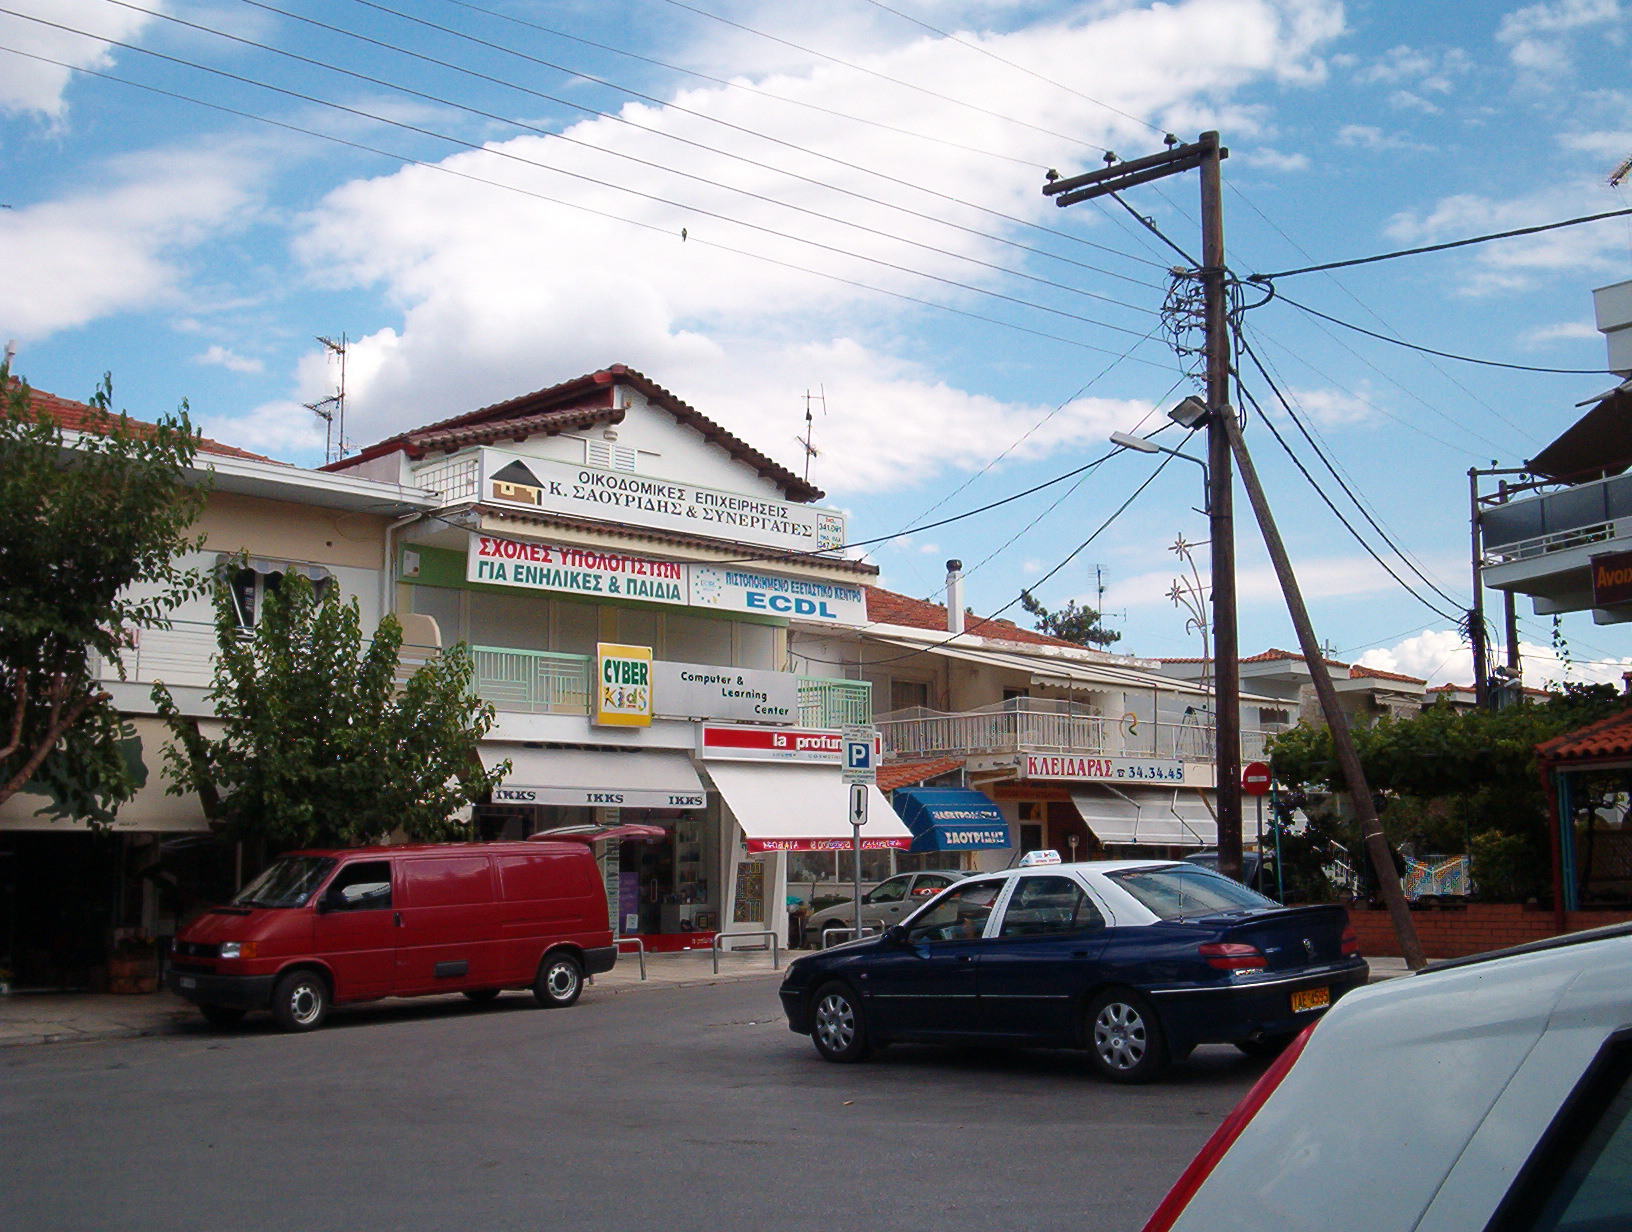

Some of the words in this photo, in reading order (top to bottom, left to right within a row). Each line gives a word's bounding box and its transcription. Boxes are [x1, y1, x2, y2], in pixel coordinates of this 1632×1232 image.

[578, 471, 686, 501] ΟΙΚΟΔΟΜΙΚΕΣ
[695, 491, 788, 519] ΕΠΙΧΕΙΡΗΣΕΙΣ
[549, 481, 568, 497] Κ.
[573, 485, 682, 516] ΣΑΟΥΡΙΔΗΣ
[686, 505, 698, 518] &
[702, 507, 812, 537] ΣΥΝΕΡΓΑΤΕΣ
[478, 537, 553, 563] ΣΧΟΛΕΣ
[558, 547, 681, 580] ΥΠΟΛΟΓΙΣΤΩΝ
[478, 560, 507, 581] ΓΙΑ
[513, 563, 603, 592] ΕΝΗΛΙΚΕΣ
[608, 576, 621, 594] &
[626, 578, 682, 601] ΠΑΙΔΙΑ
[746, 591, 837, 619] ECDL
[604, 658, 648, 686] CYBER
[680, 671, 732, 686] Computer
[736, 675, 744, 686] &
[721, 687, 768, 703] Learning
[754, 704, 789, 716] Center
[773, 733, 787, 747] la
[852, 745, 866, 766] P
[1028, 756, 1113, 778] ΚΛΕΙΔΑΡΑΣ
[1128, 766, 1183, 780] 34.34.45
[495, 790, 536, 801] IKKS
[586, 793, 624, 804] IKKS
[668, 795, 703, 806] IKKS
